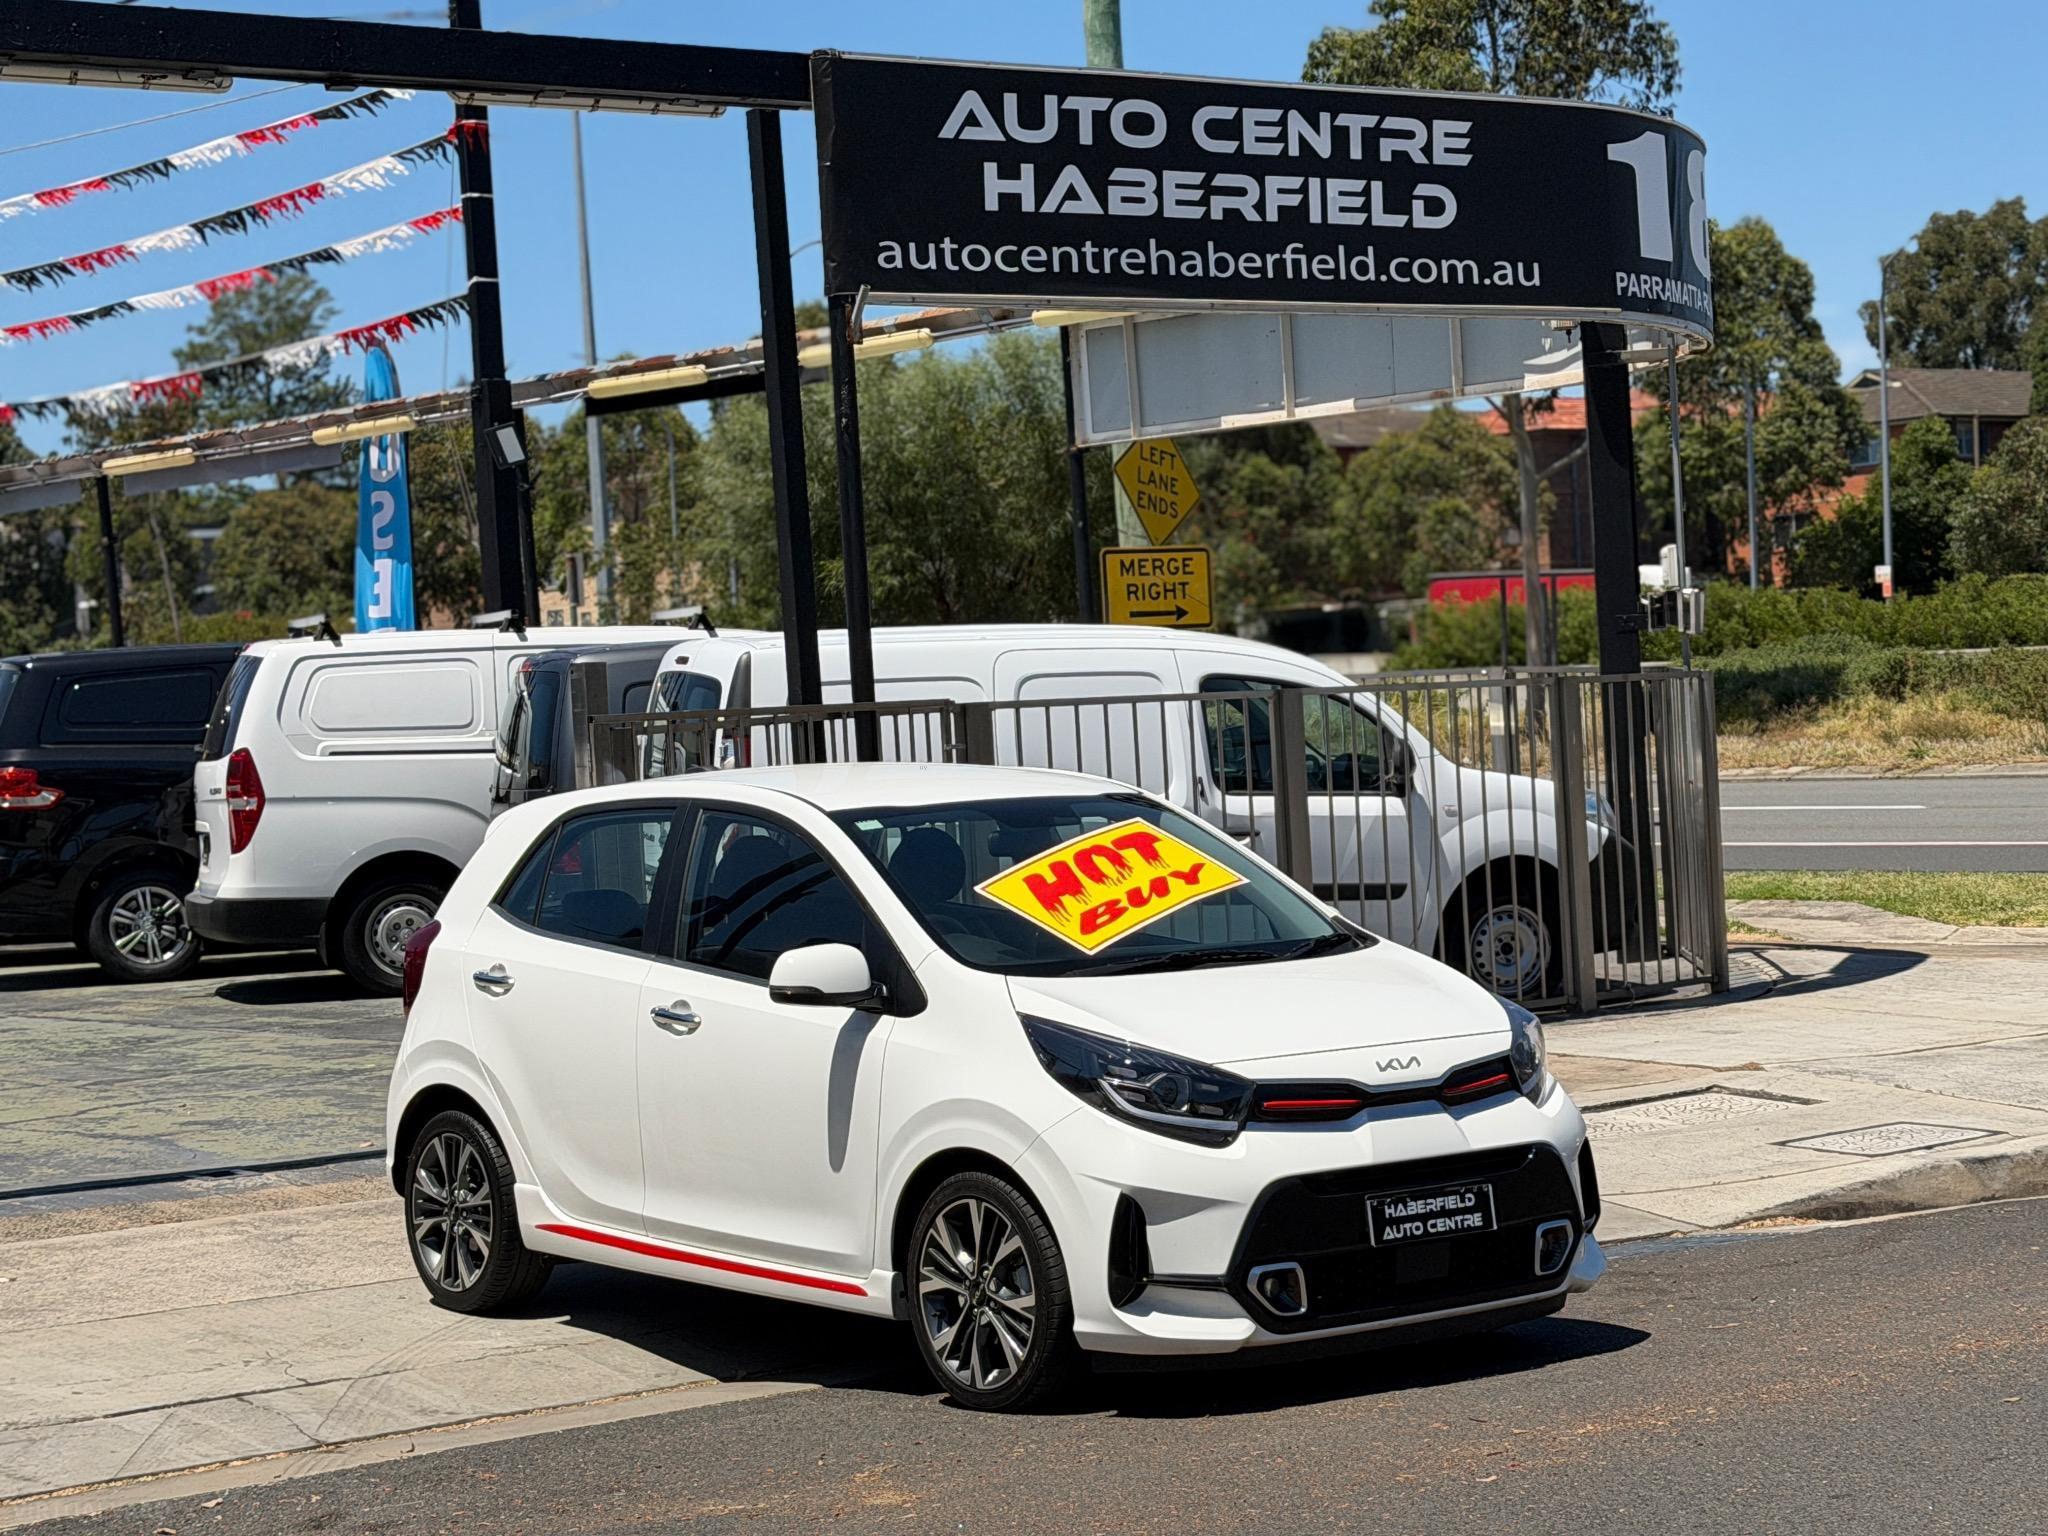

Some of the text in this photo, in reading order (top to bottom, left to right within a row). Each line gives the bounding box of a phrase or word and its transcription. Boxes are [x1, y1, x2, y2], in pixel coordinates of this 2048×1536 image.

[938, 89, 1473, 167] AUTO CENTRE
[982, 160, 1457, 230] HABERFIELD
[877, 234, 1542, 289] autocentrehaberfield.com.au
[1616, 271, 1703, 312] PARRAMATTA
[1139, 442, 1177, 471] LEFT
[1137, 465, 1179, 496] LANE
[1136, 490, 1179, 519] ENDS
[1119, 557, 1195, 577] MERGE
[1126, 581, 1190, 602] RIGHT
[1022, 831, 1164, 927] HOT
[1079, 862, 1206, 936] BUY
[1384, 1193, 1476, 1218] HABERFIELD
[1382, 1212, 1484, 1241] AUTO CENTRE
